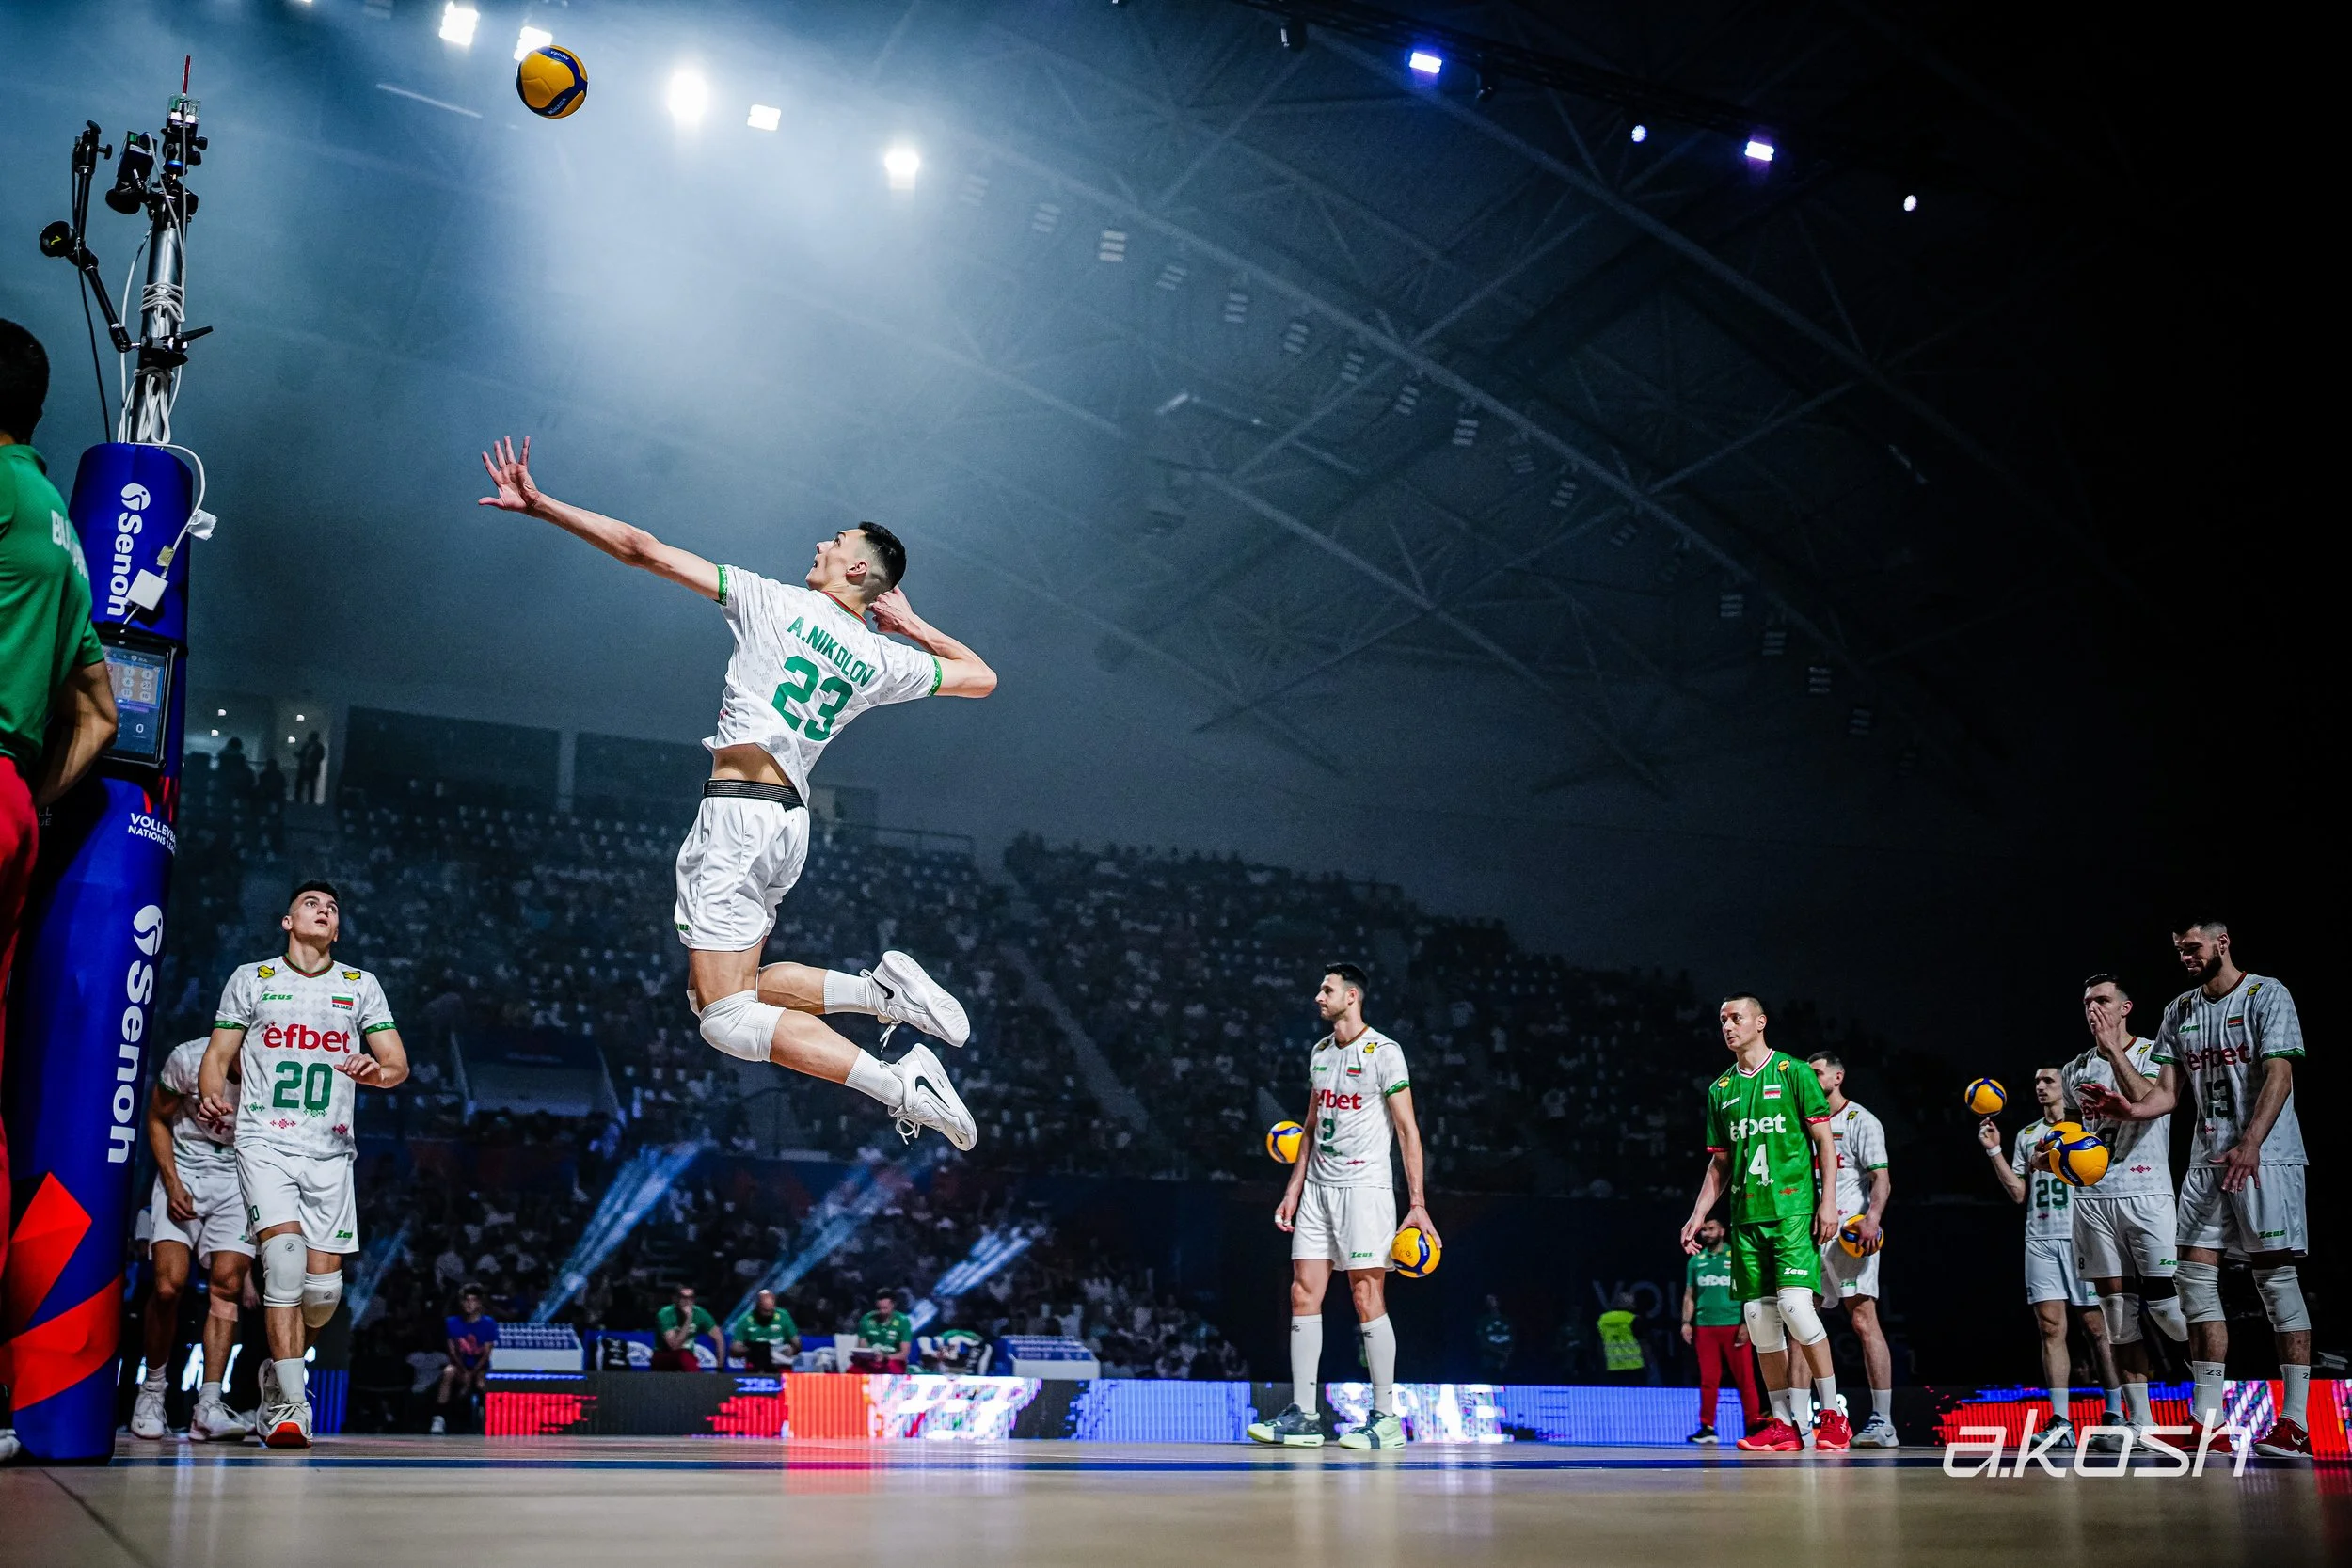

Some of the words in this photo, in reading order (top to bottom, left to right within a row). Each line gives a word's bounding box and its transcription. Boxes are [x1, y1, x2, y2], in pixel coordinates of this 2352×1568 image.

[107, 512, 143, 616] Senoh
[787, 616, 876, 688] A.NIKOLOV
[771, 656, 853, 742] 23
[128, 825, 166, 846] NATIONS
[262, 1022, 351, 1053] efbet
[108, 959, 153, 1164] Senoh
[2185, 1041, 2252, 1071] efbet
[272, 1061, 333, 1111] 20
[1722, 1097, 1740, 1109] Zeus
[1730, 1113, 1787, 1142] efbet
[2035, 1179, 2068, 1208] 29
[2259, 1229, 2286, 1239] Zeus
[1784, 1267, 1809, 1275] Zeus
